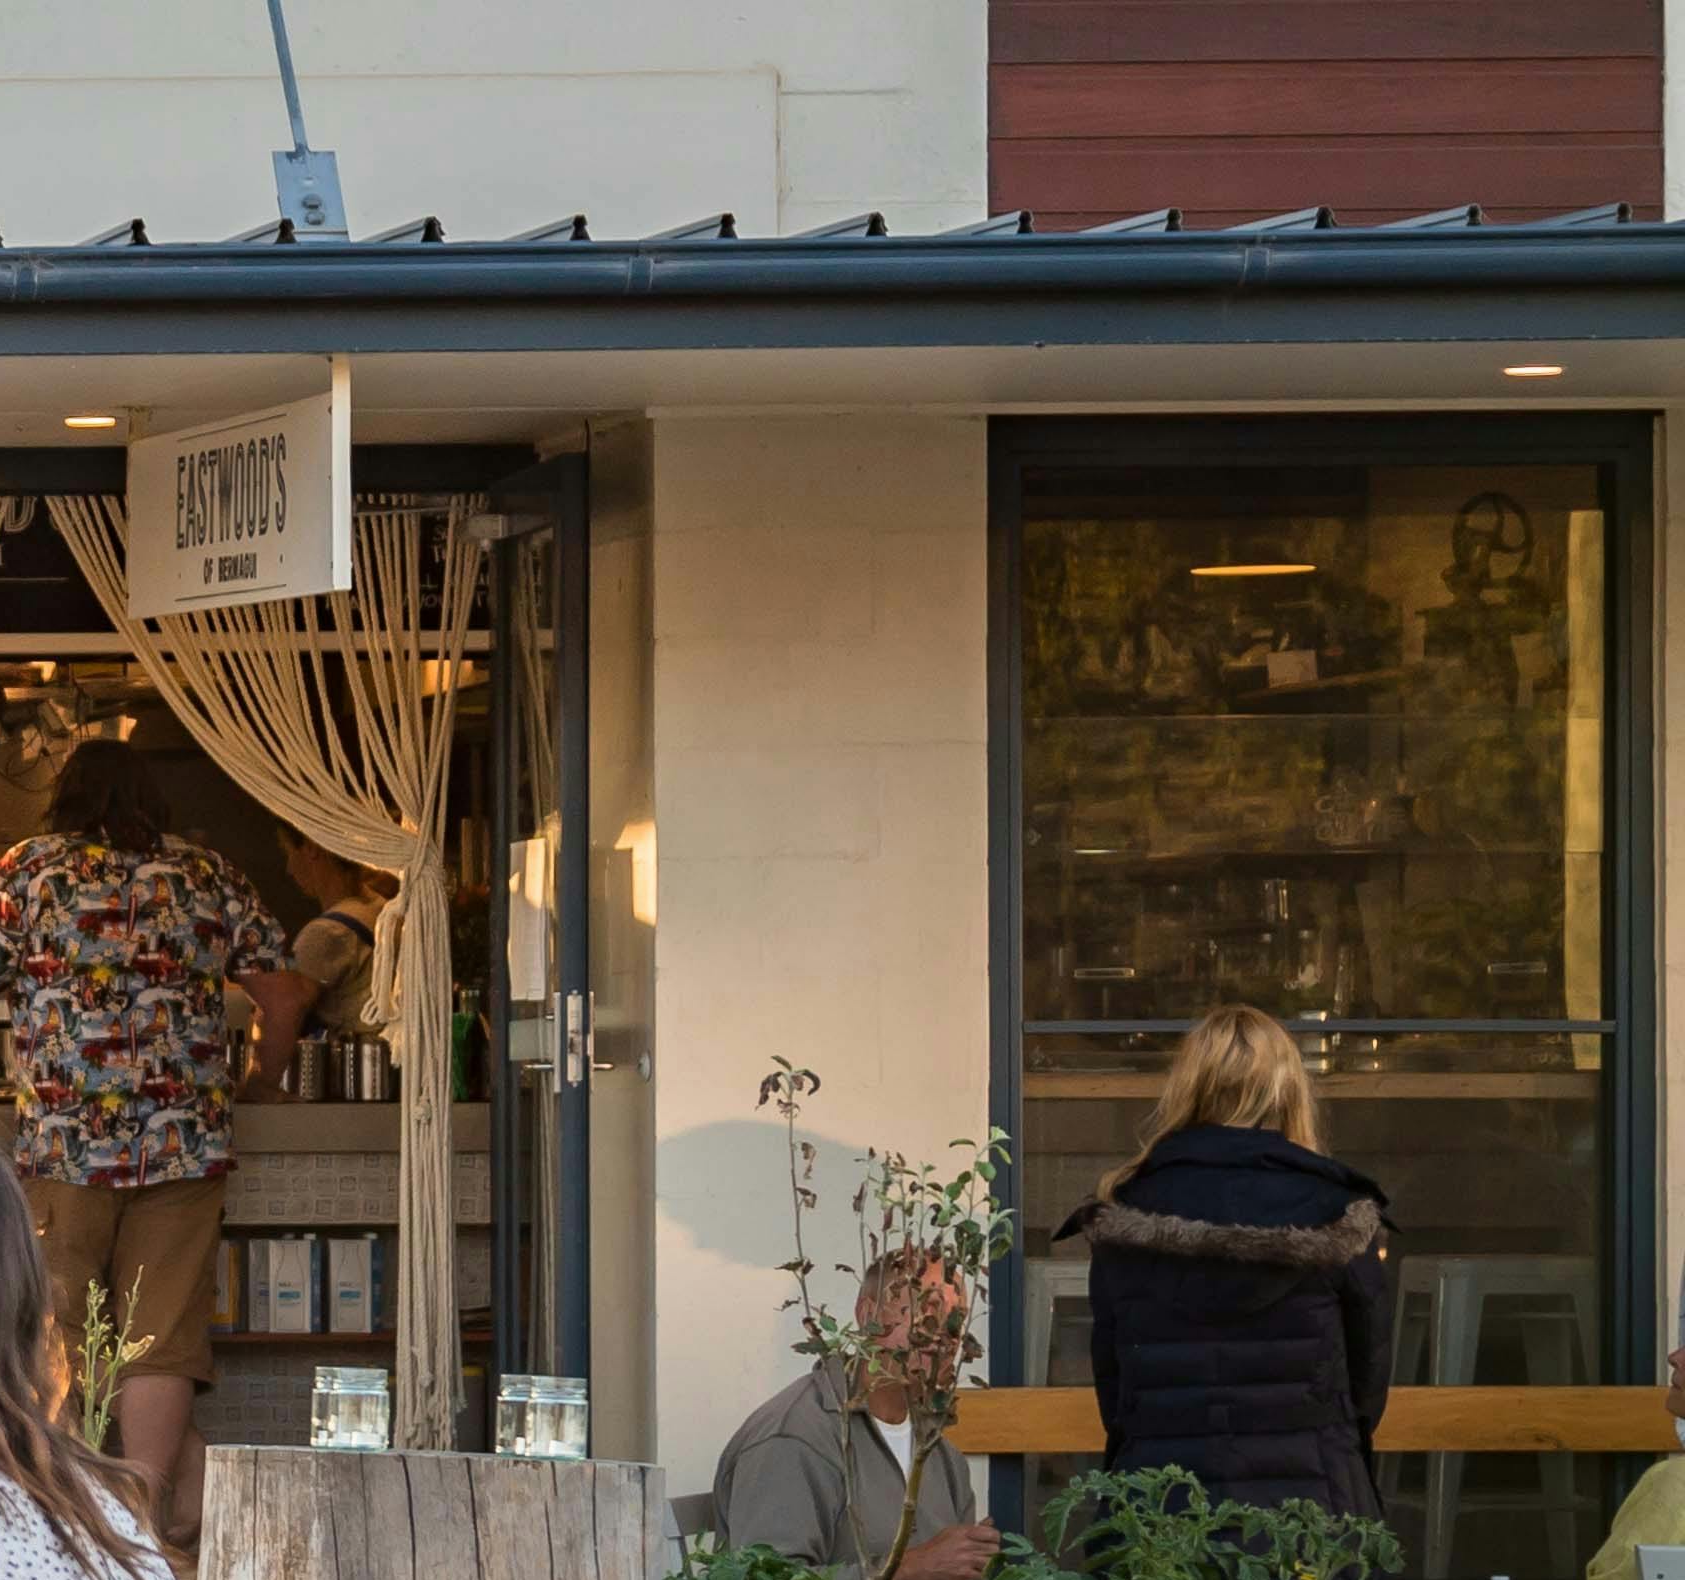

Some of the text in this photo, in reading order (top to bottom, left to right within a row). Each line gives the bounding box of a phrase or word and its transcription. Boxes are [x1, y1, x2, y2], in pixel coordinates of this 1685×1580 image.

[176, 432, 287, 550] EASTWOOD'S
[203, 552, 257, 584] OF BERMAGUI
